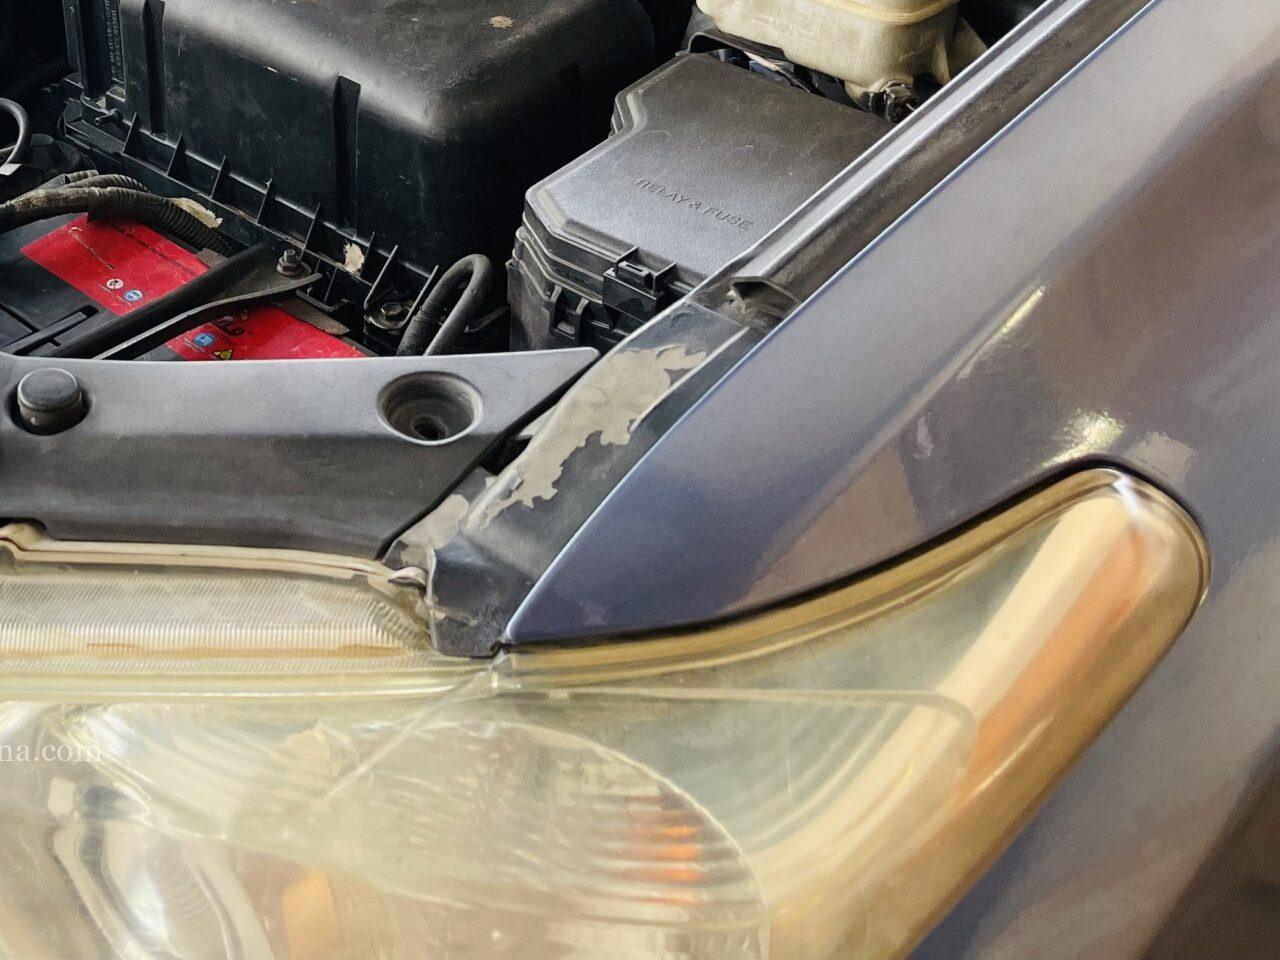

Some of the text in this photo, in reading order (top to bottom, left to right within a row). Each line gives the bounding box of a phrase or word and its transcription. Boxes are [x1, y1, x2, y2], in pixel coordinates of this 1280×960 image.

[634, 177, 754, 230] RELAY & FUSE
